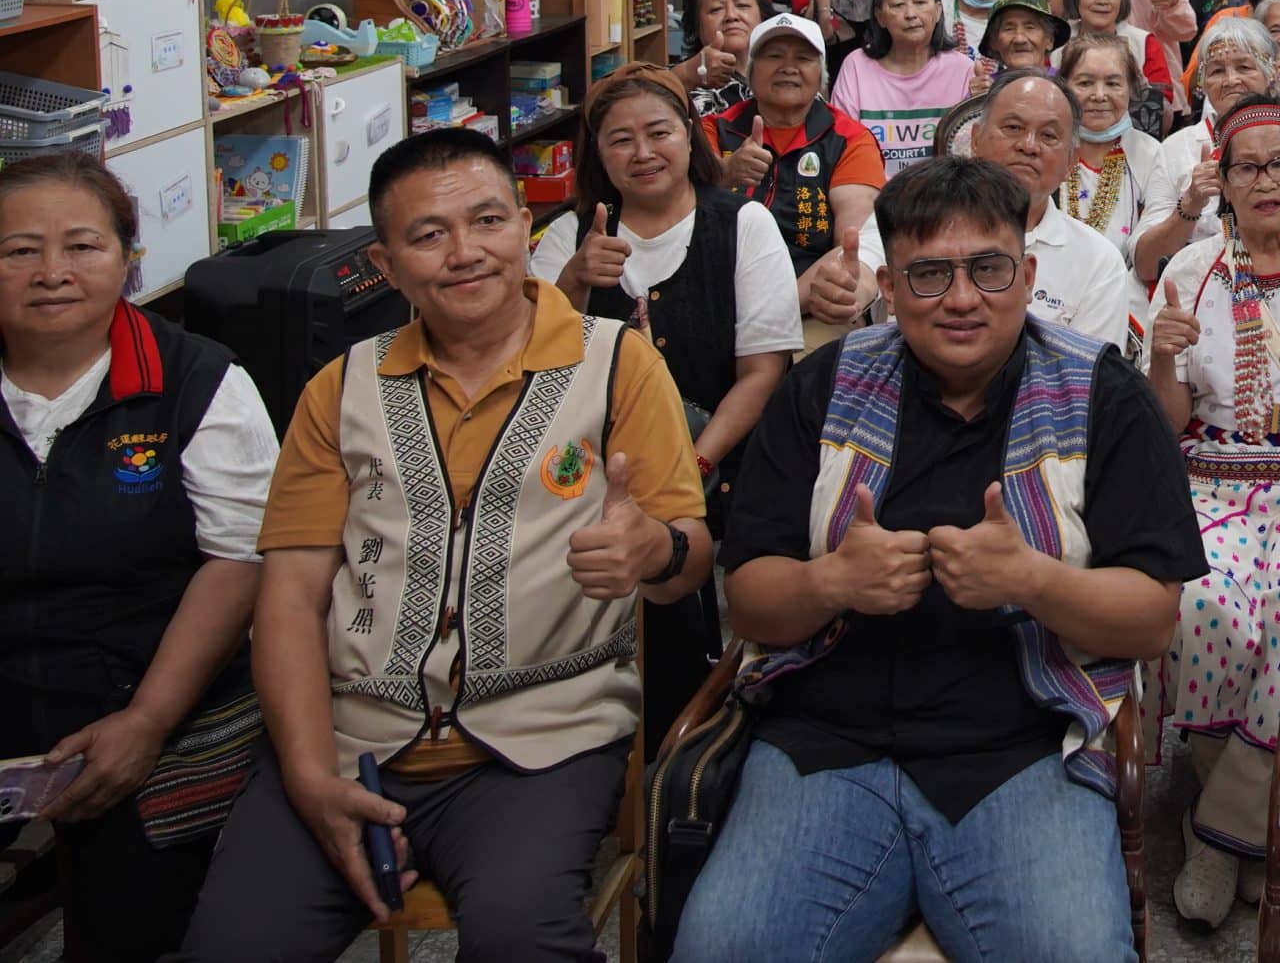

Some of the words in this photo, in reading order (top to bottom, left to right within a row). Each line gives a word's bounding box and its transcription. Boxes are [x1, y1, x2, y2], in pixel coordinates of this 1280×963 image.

[882, 149, 919, 159] COURT
[367, 457, 384, 501] 代表
[346, 537, 384, 634] 劉光照
